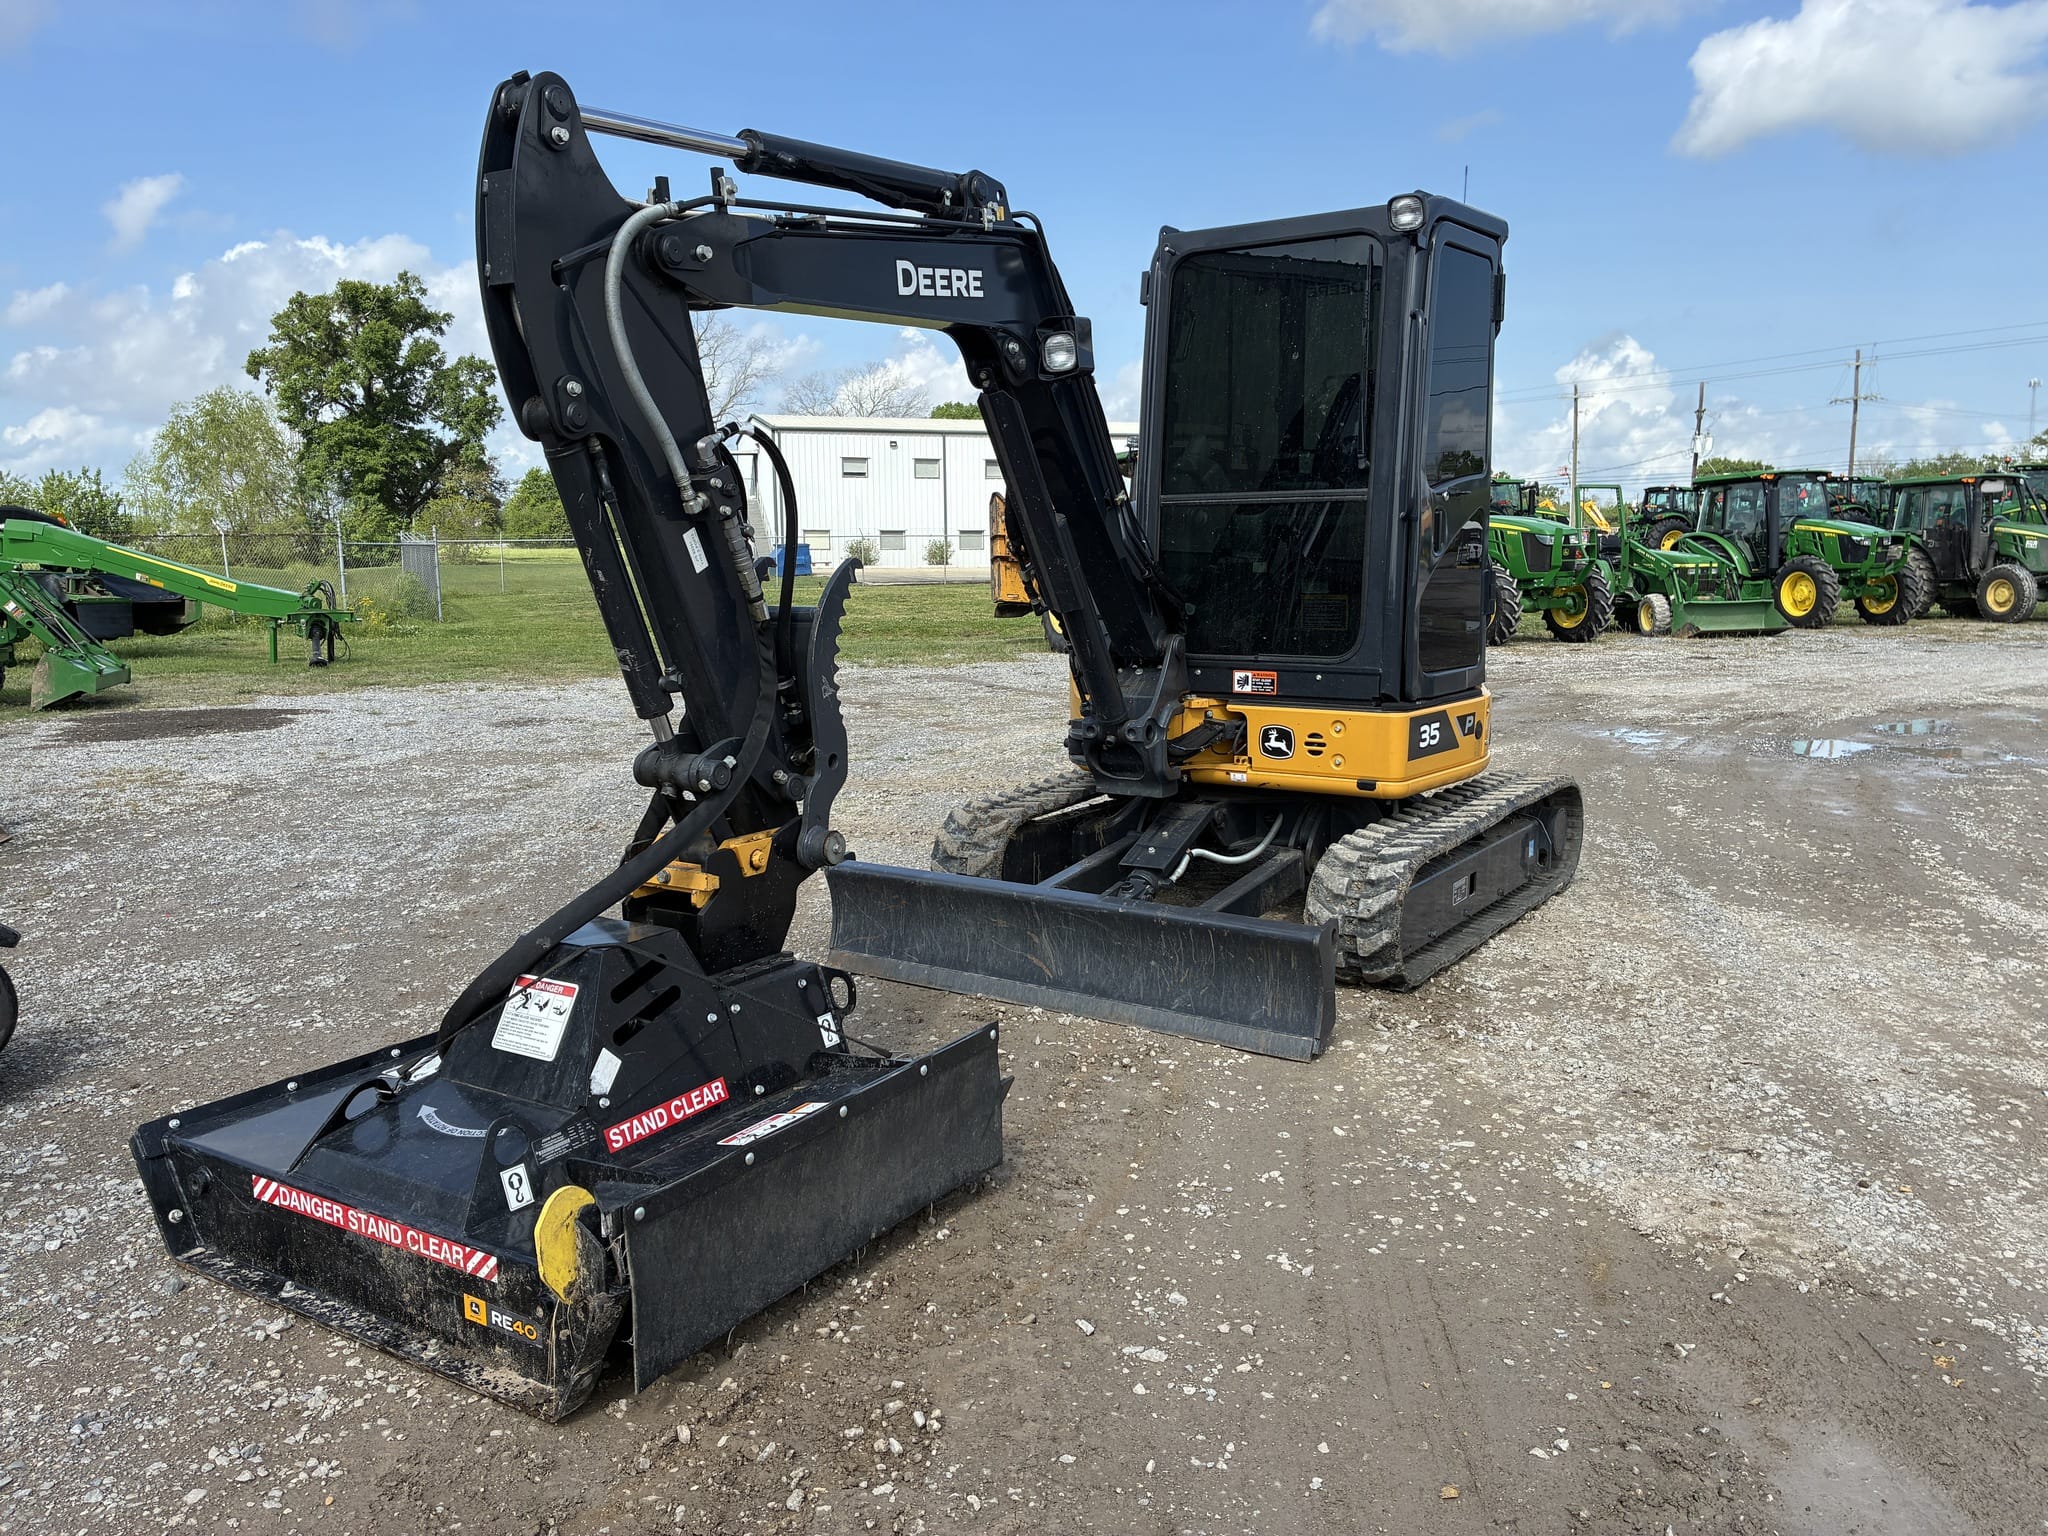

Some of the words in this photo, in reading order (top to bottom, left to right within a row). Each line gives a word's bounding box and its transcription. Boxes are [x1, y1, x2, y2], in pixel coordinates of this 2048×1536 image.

[895, 259, 984, 298] DEERE
[1419, 721, 1441, 748] 35
[536, 982, 564, 994] DANGER
[608, 1111, 668, 1149] STAND
[670, 1081, 726, 1120] CLEAR
[279, 1186, 344, 1226] DANGER
[348, 1212, 403, 1245] STAND
[406, 1230, 465, 1268] CLEAR
[491, 1310, 538, 1341] RE40
